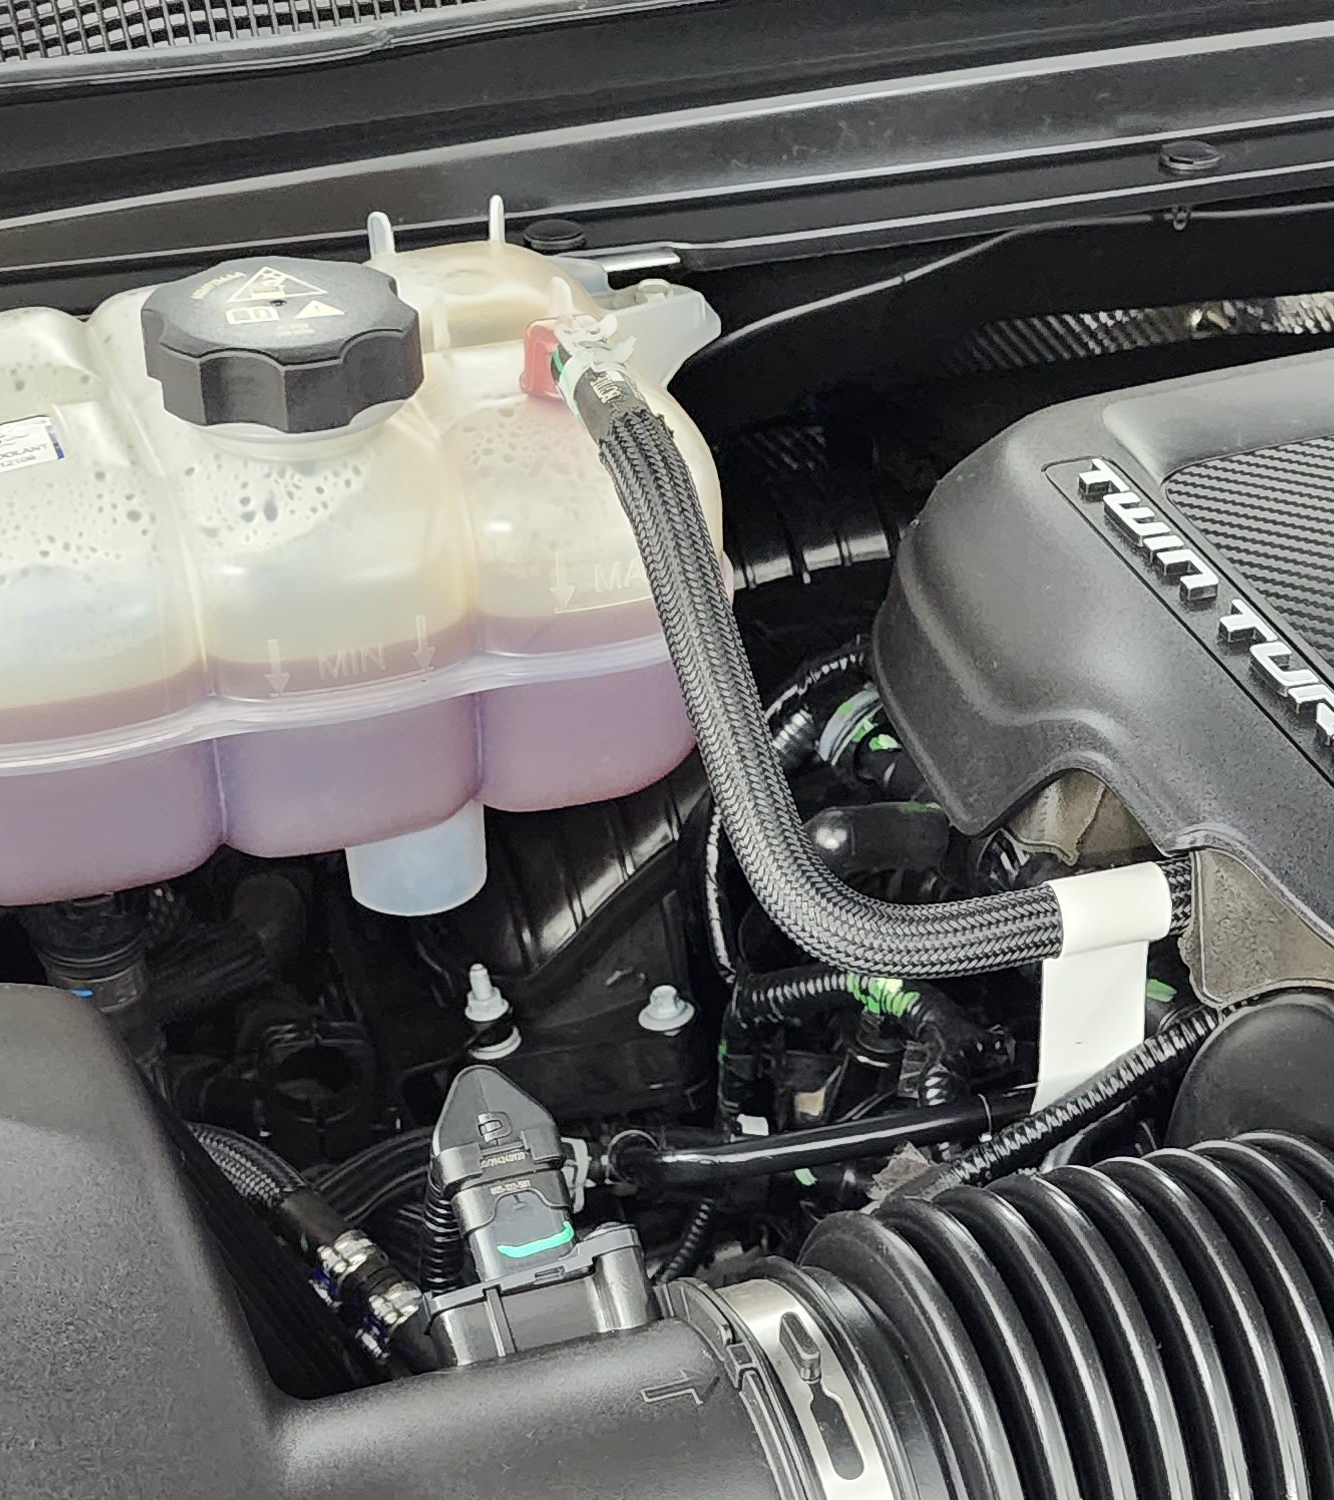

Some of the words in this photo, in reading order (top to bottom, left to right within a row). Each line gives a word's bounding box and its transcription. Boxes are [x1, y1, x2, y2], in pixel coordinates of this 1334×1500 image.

[1078, 458, 1219, 598] TWIN
[593, 557, 645, 592] MA
[316, 643, 387, 683] MIN
